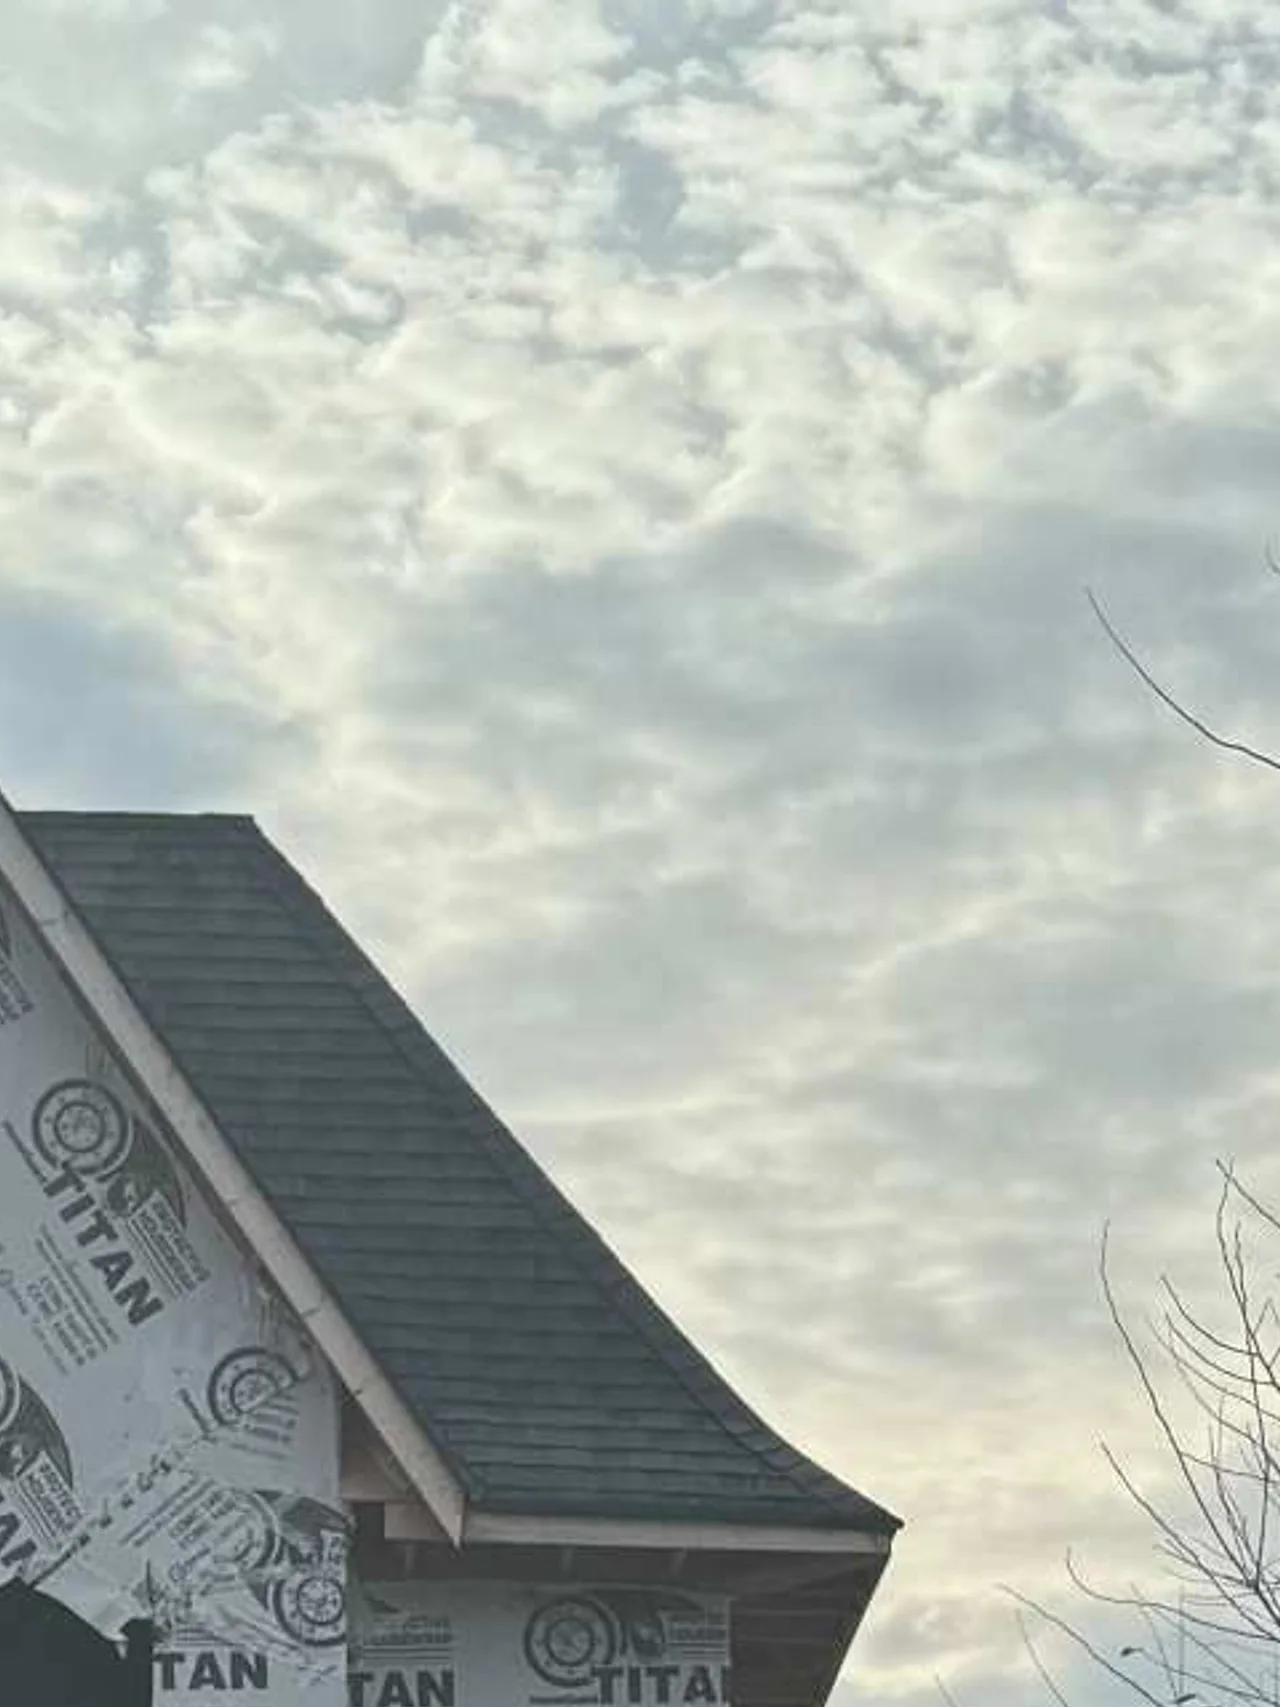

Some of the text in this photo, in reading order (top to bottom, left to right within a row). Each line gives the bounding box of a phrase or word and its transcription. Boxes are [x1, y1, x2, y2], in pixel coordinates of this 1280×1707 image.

[41, 1162, 166, 1328] TITAN
[153, 1651, 269, 1690] TAN
[347, 1670, 456, 1707] TAN
